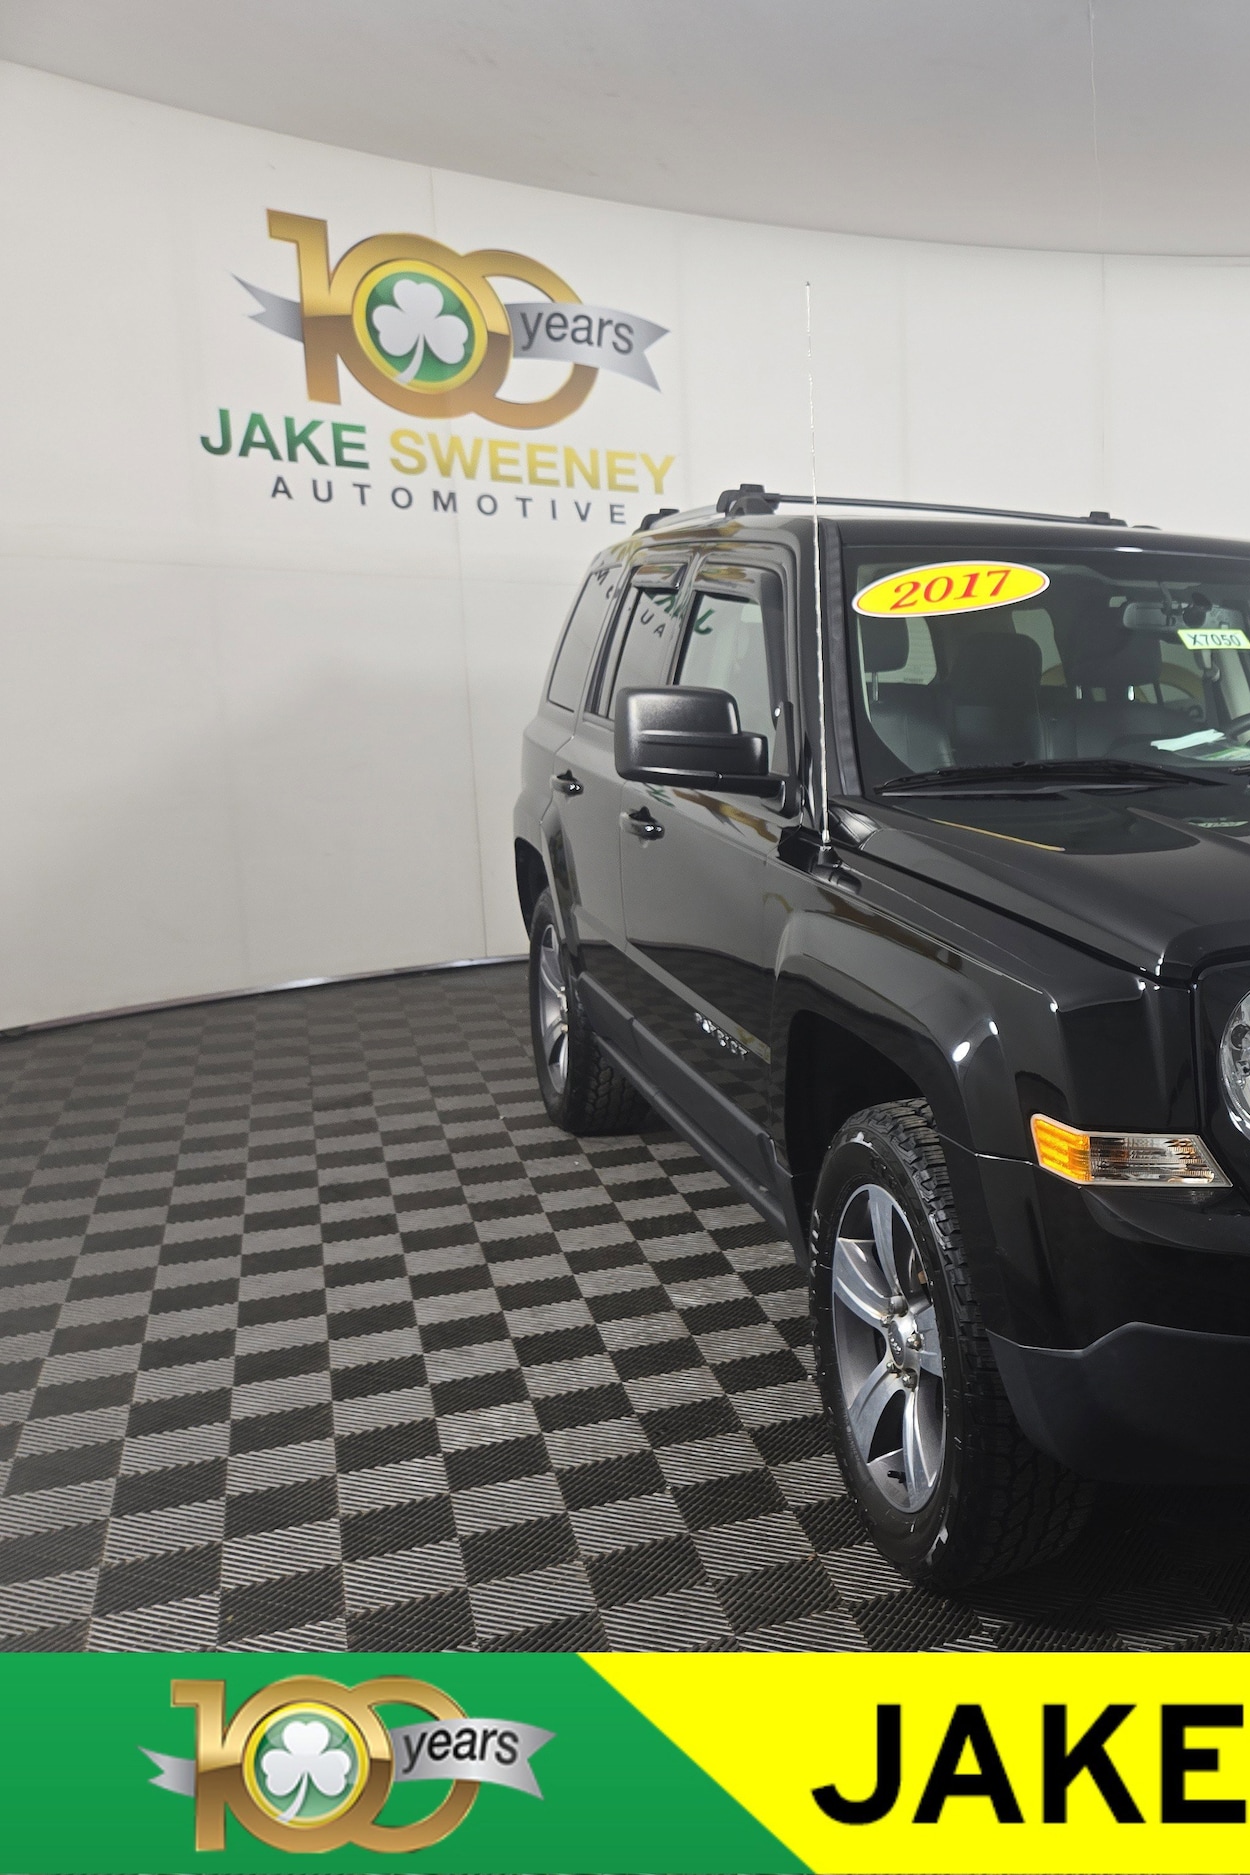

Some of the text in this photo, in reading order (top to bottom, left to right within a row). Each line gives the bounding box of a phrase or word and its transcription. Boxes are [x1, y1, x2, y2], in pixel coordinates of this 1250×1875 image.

[519, 307, 636, 357] years
[200, 407, 677, 495] JAKE SWEENEY
[270, 475, 628, 526] AUTOMOTIVE
[889, 568, 1012, 611] 2017
[1187, 633, 1242, 647] X7050
